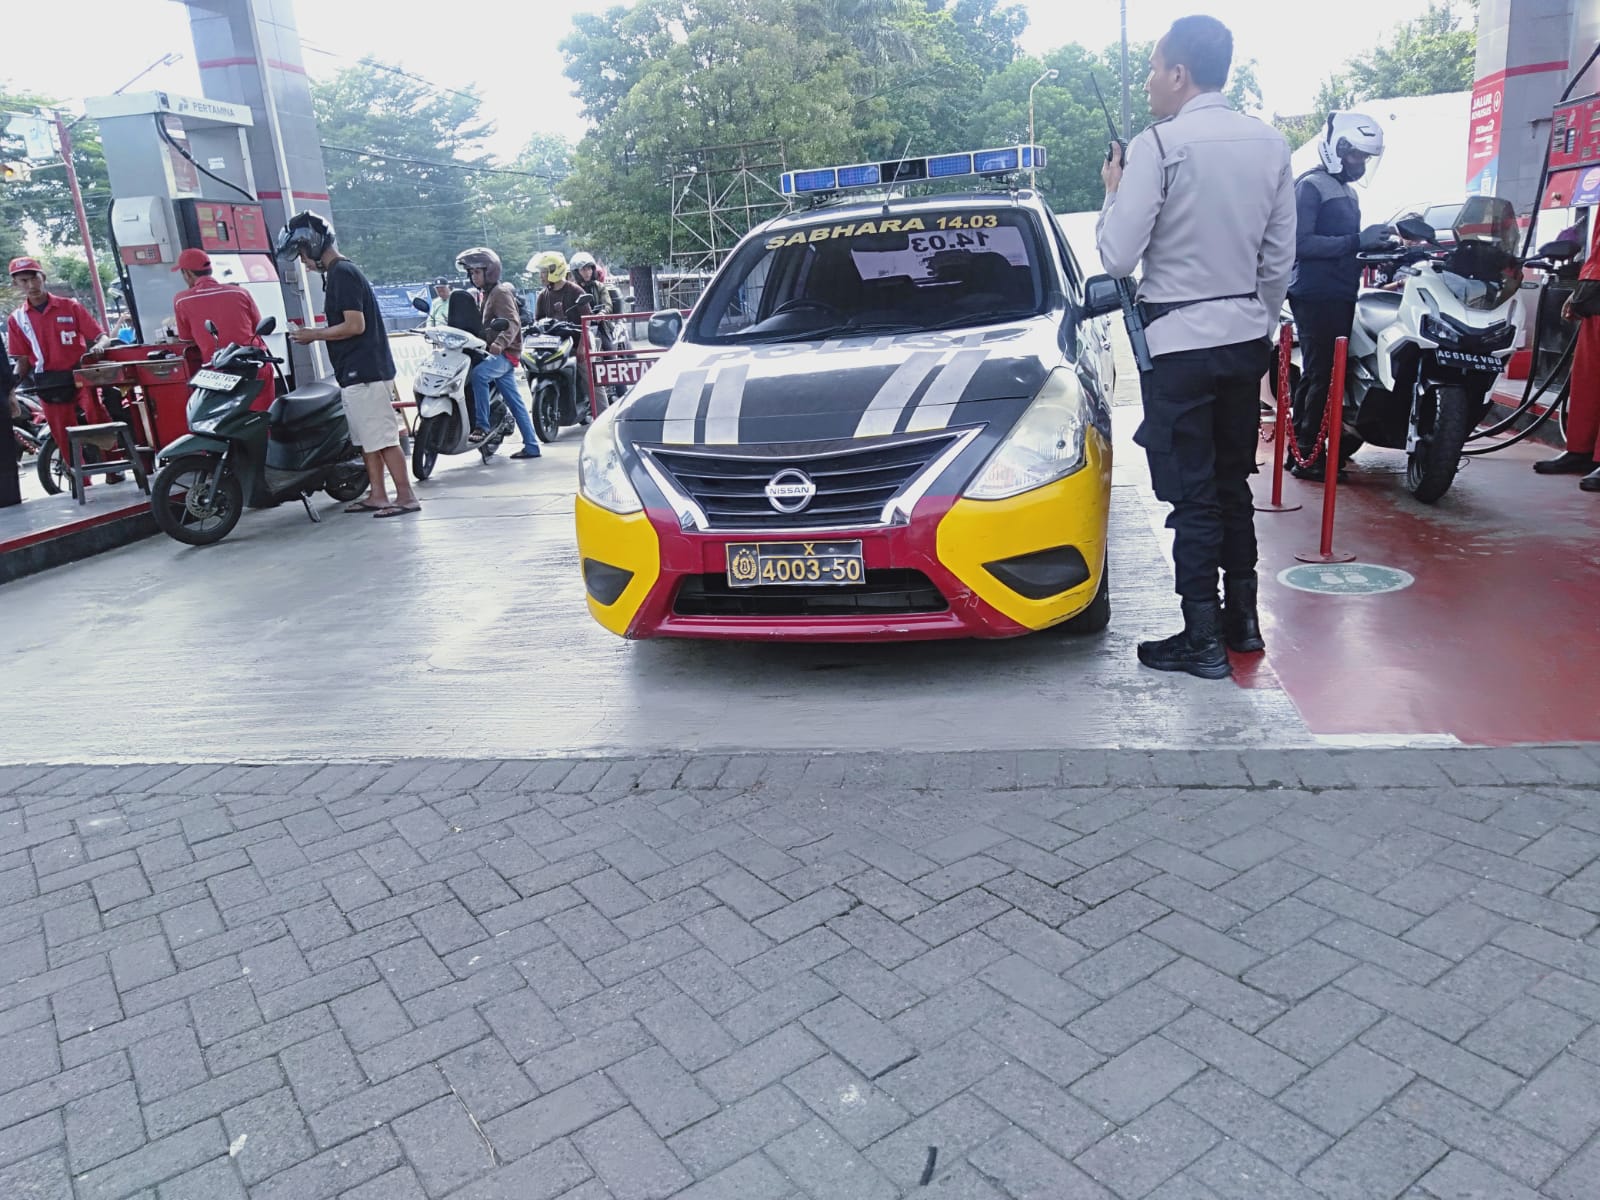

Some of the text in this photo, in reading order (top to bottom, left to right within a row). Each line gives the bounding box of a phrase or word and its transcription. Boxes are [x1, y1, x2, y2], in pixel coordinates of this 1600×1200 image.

[192, 102, 236, 117] PERTAMINA
[1472, 93, 1492, 110] JALUR
[765, 214, 998, 250] SABHARA 14.03
[698, 333, 986, 368] POLISI
[595, 361, 655, 384] PERTA
[769, 487, 810, 495] NISSAN
[803, 543, 816, 556] X
[762, 558, 860, 581] 4003-50
